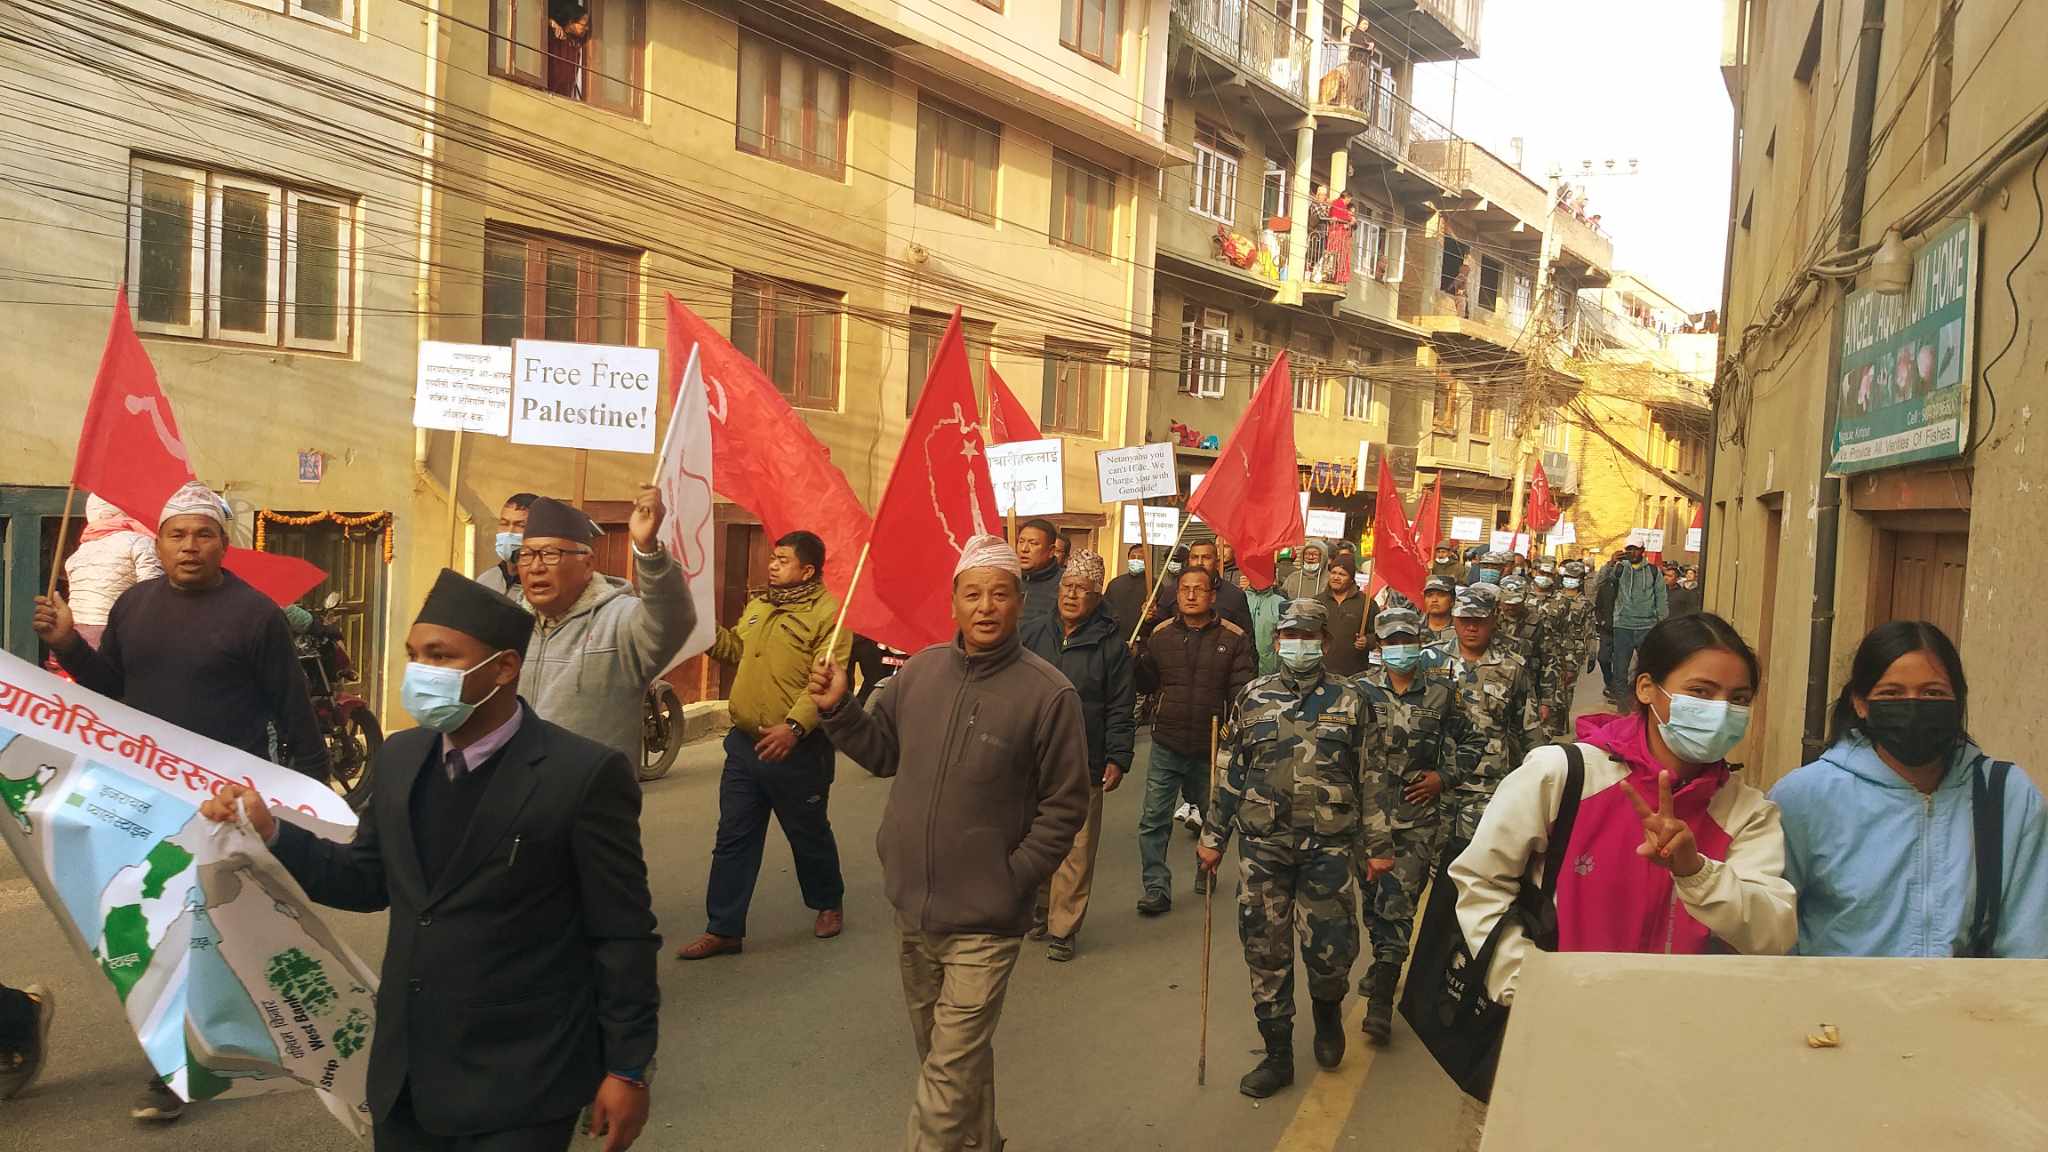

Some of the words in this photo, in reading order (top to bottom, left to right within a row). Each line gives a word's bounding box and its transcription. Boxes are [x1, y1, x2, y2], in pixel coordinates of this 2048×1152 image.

[1843, 290, 1874, 357] ANGEL
[1930, 227, 1966, 314] HOME
[523, 357, 581, 386] Free
[590, 362, 650, 391] Free
[520, 397, 648, 430] Palestine!
[1150, 451, 1165, 460] you
[1106, 476, 1133, 487] Charge
[1136, 474, 1150, 484] you
[1152, 471, 1169, 480] with
[283, 993, 310, 1023] Bank
[301, 1023, 325, 1052] West
[320, 1059, 340, 1088] Strip
